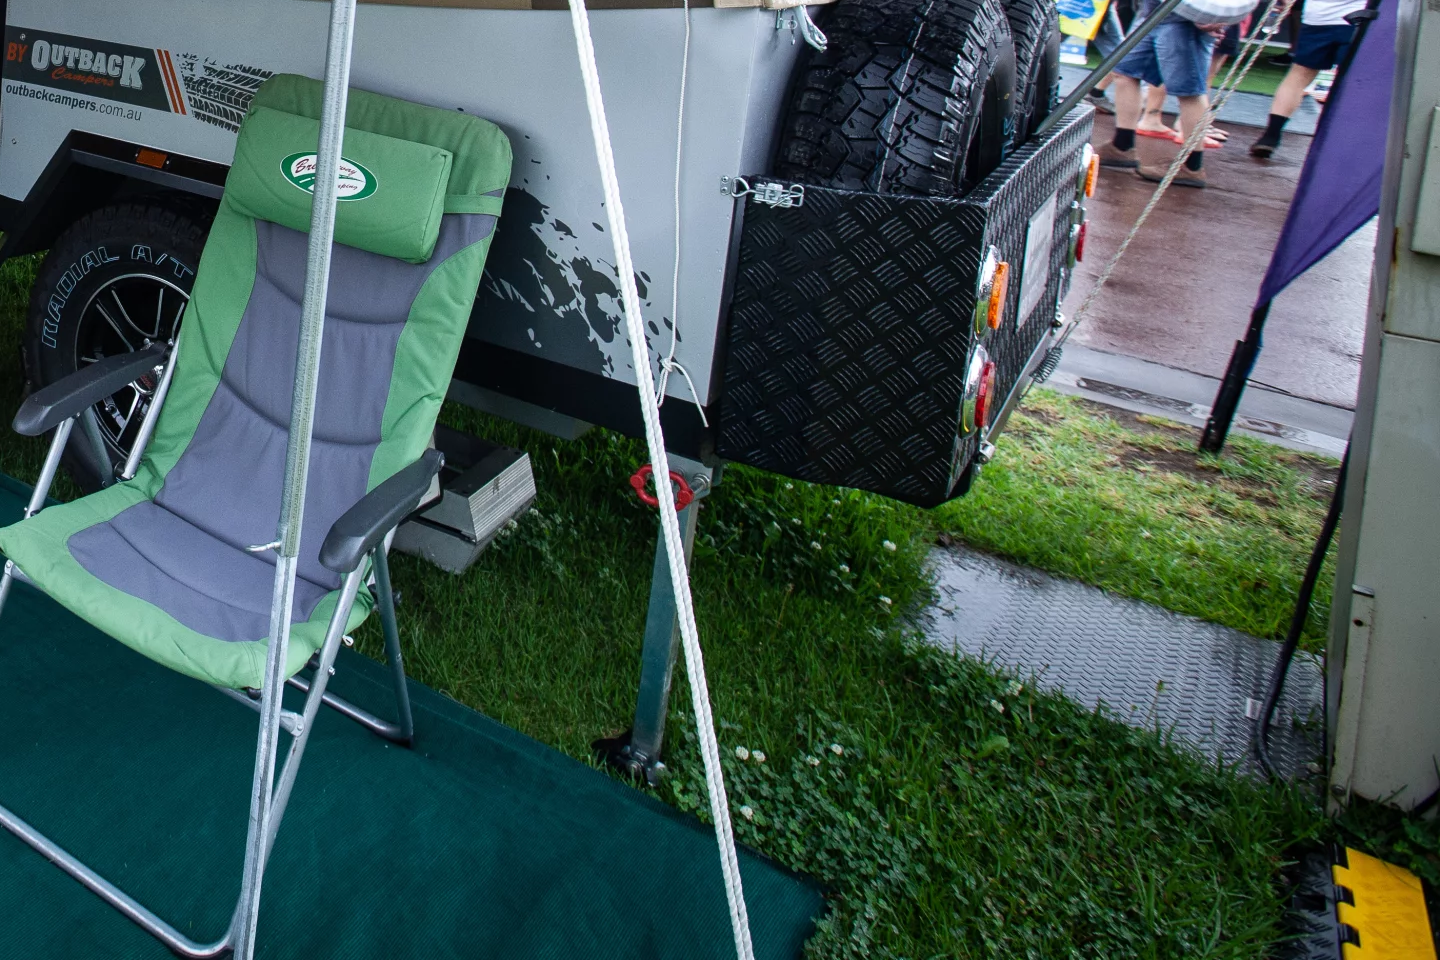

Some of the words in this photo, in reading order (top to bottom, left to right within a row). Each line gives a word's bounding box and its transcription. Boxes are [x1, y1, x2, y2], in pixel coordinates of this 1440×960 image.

[6, 41, 28, 63] BY
[31, 39, 147, 90] OUTBACK
[51, 67, 115, 87] Campers
[5, 84, 142, 121] outbackcampers.com.au
[42, 246, 120, 349] RADIAL
[131, 244, 194, 279] A/T
